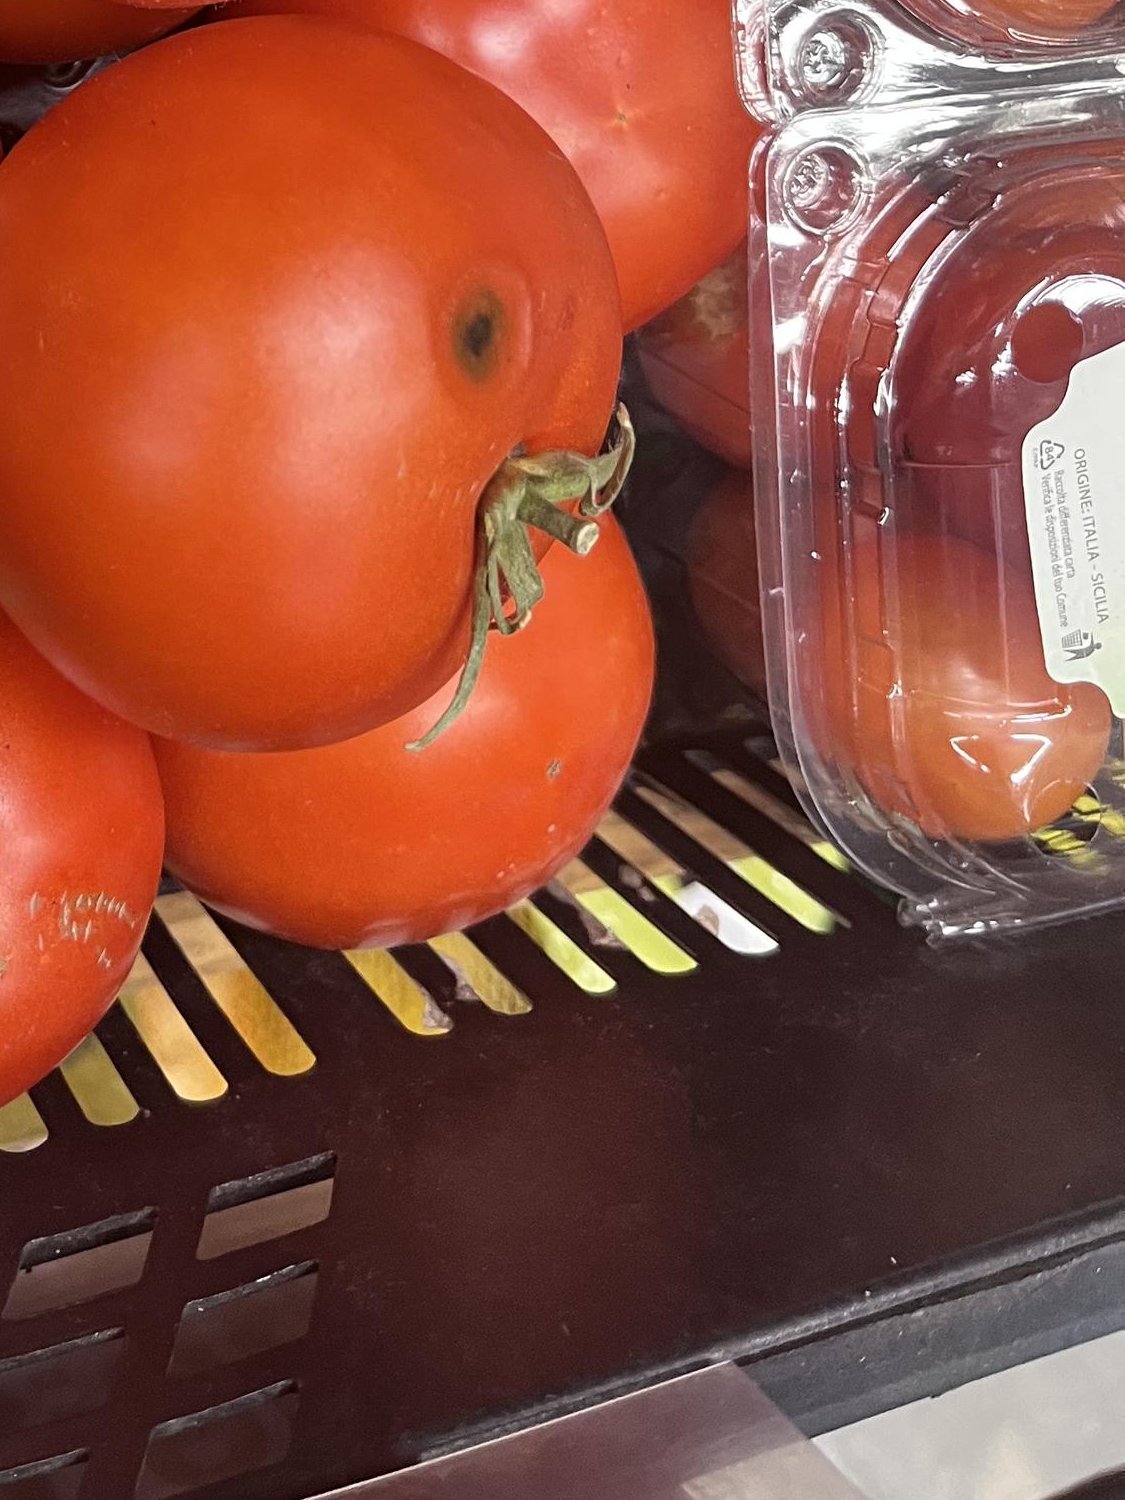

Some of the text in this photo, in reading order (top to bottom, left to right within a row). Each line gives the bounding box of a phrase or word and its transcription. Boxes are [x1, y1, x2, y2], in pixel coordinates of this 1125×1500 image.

[1044, 446, 1055, 461] 84
[1074, 448, 1093, 514] ORIGINE:
[1041, 473, 1069, 628] Verifica le disposizioni del tuo Comune
[1053, 469, 1076, 579] Raccolta differenziata carta
[1082, 515, 1100, 562] ITALIA
[1091, 573, 1109, 624] SICILIA
